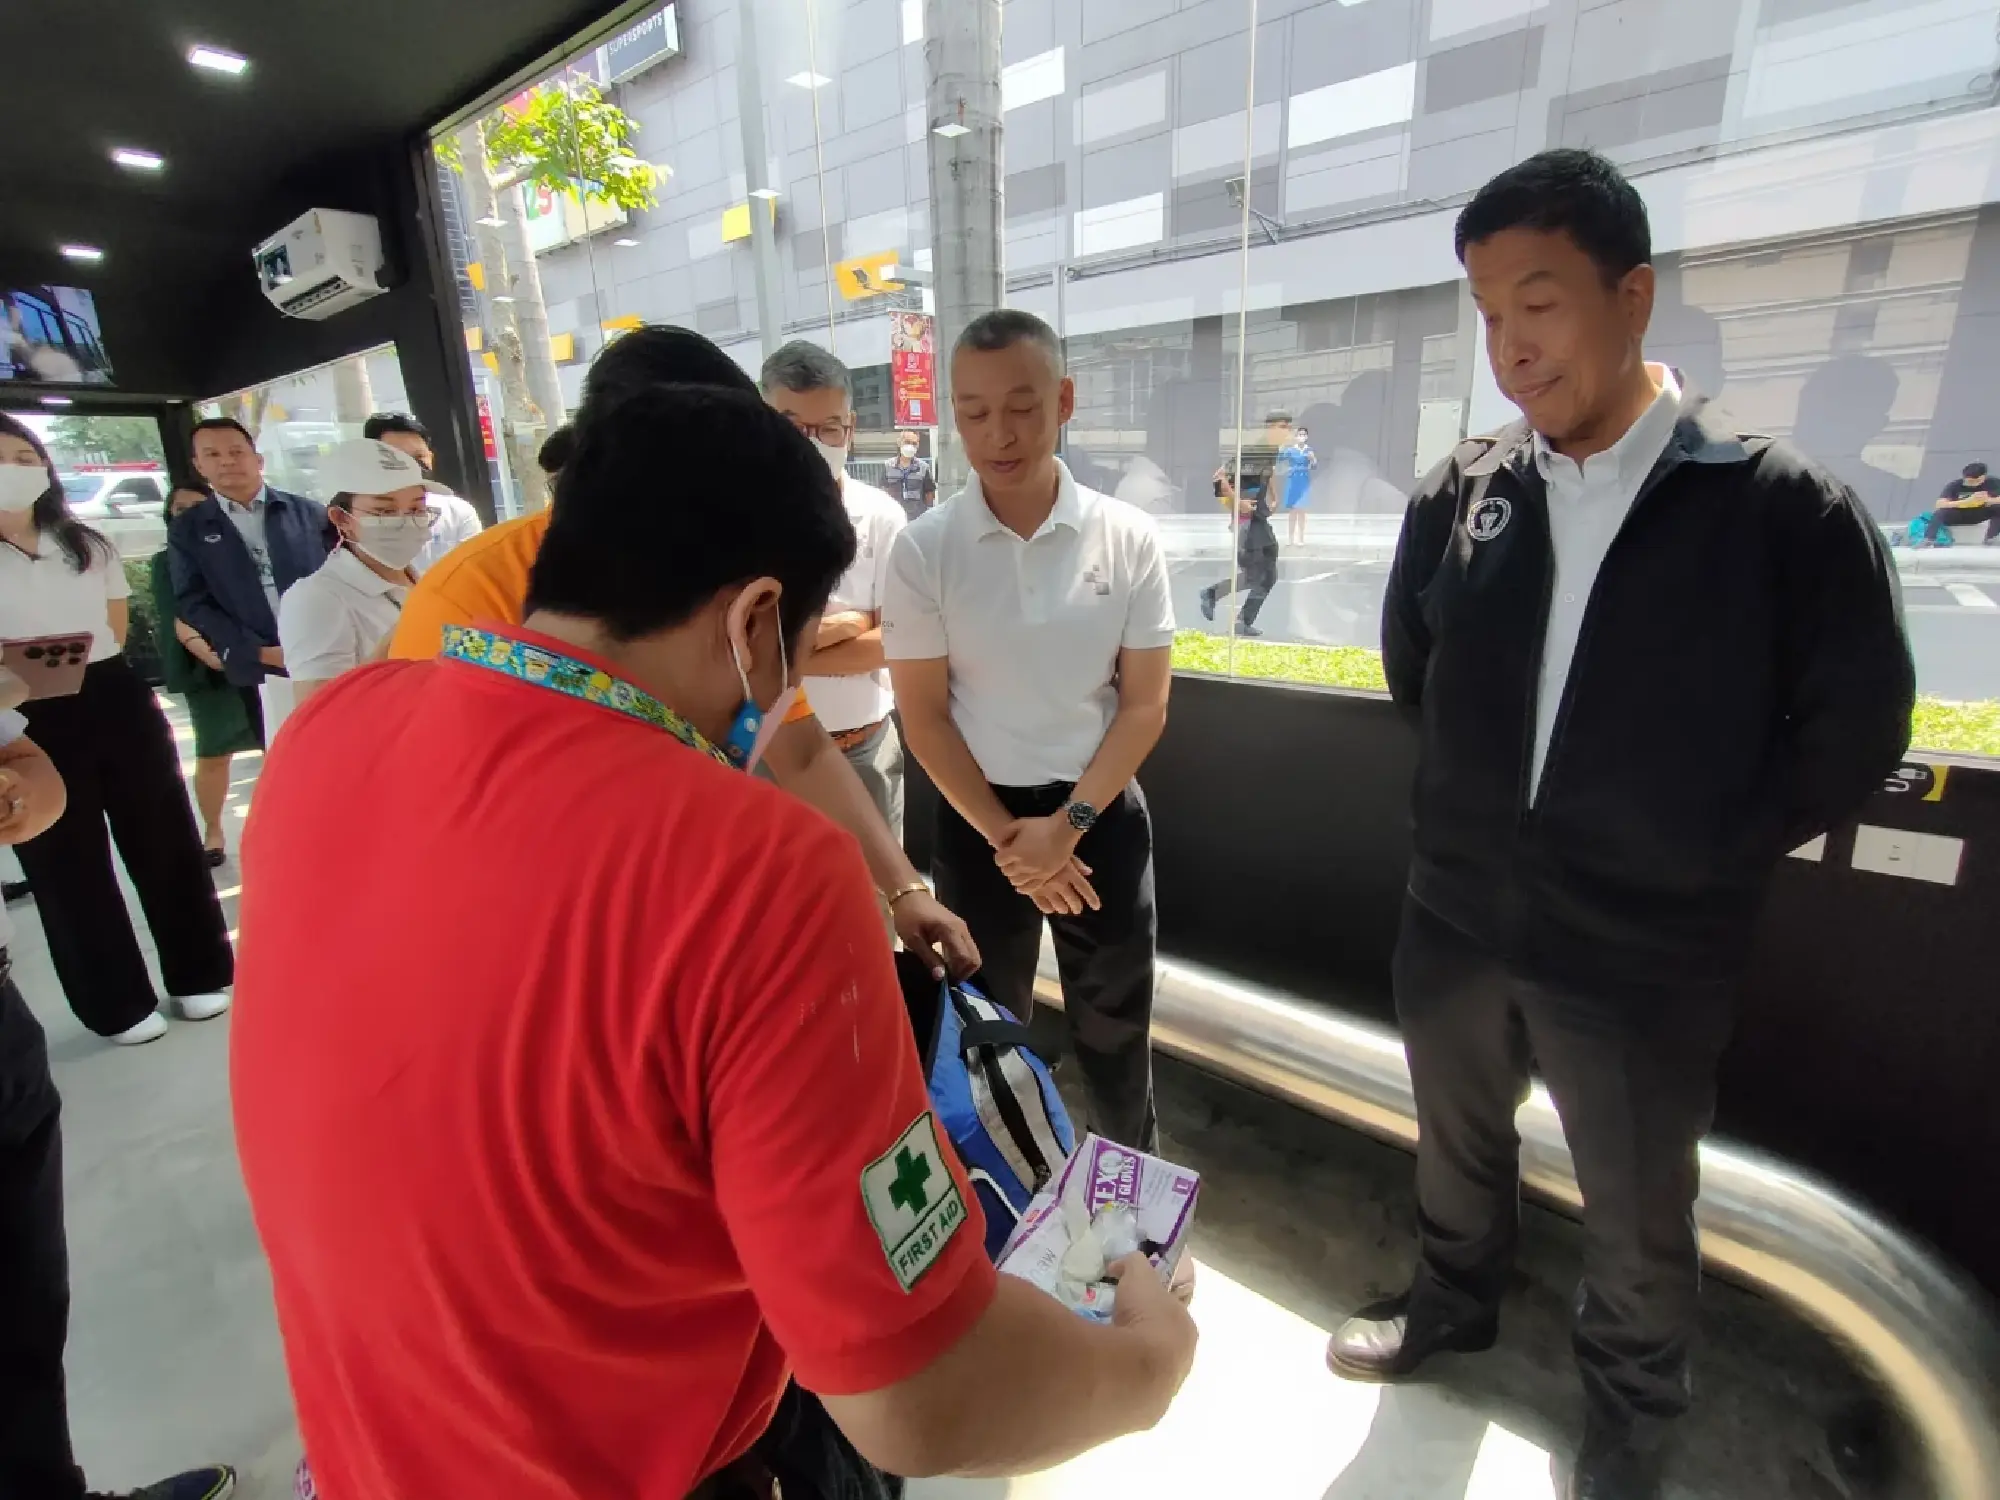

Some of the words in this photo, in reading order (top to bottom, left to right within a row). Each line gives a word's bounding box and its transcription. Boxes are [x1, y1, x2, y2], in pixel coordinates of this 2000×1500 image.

[608, 11, 663, 56] SUPERSPORTS
[1118, 1156, 1136, 1196] GLOVES
[898, 1222, 940, 1277] FIRST
[938, 1200, 960, 1231] AID
